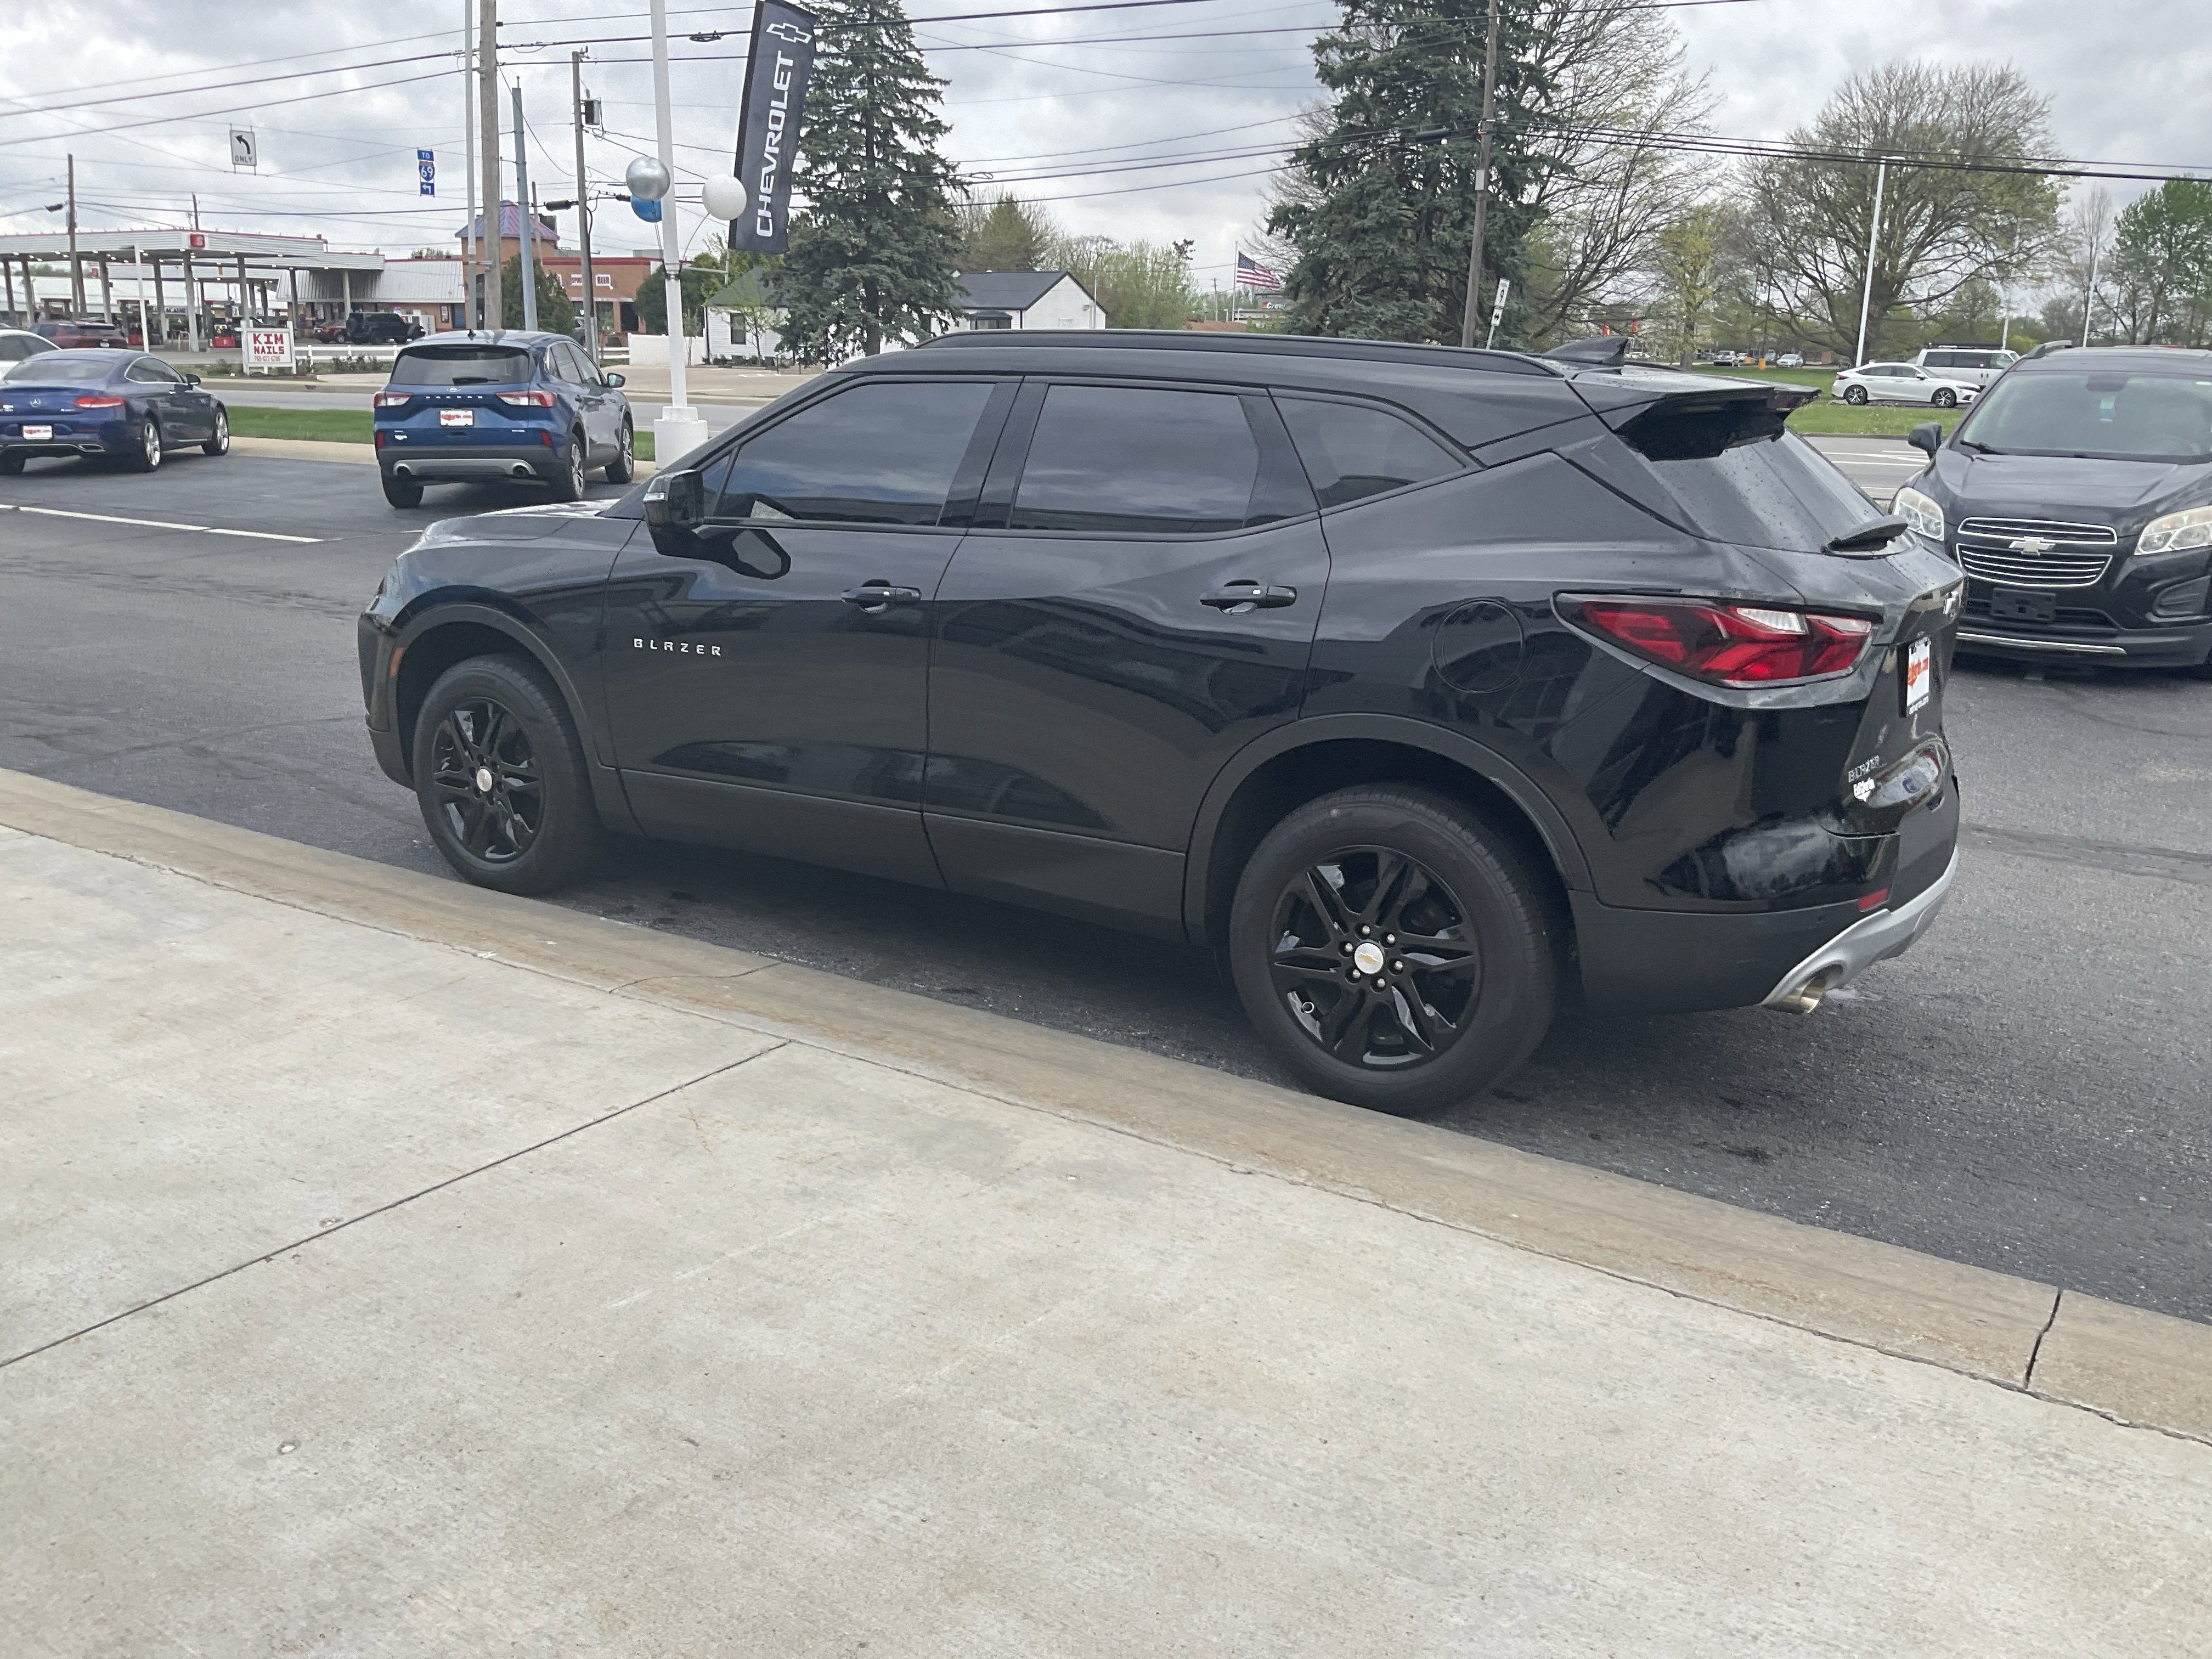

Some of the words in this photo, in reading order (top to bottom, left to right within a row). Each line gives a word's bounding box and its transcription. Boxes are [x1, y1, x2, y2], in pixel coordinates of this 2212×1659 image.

[757, 50, 793, 237] CHEVROLET
[421, 166, 433, 178] 69
[1499, 289, 1504, 303] 9
[253, 333, 284, 345] KIM
[254, 346, 285, 354] NAILS
[634, 638, 721, 656] BLAZER
[1848, 755, 1880, 783] BLAZER
